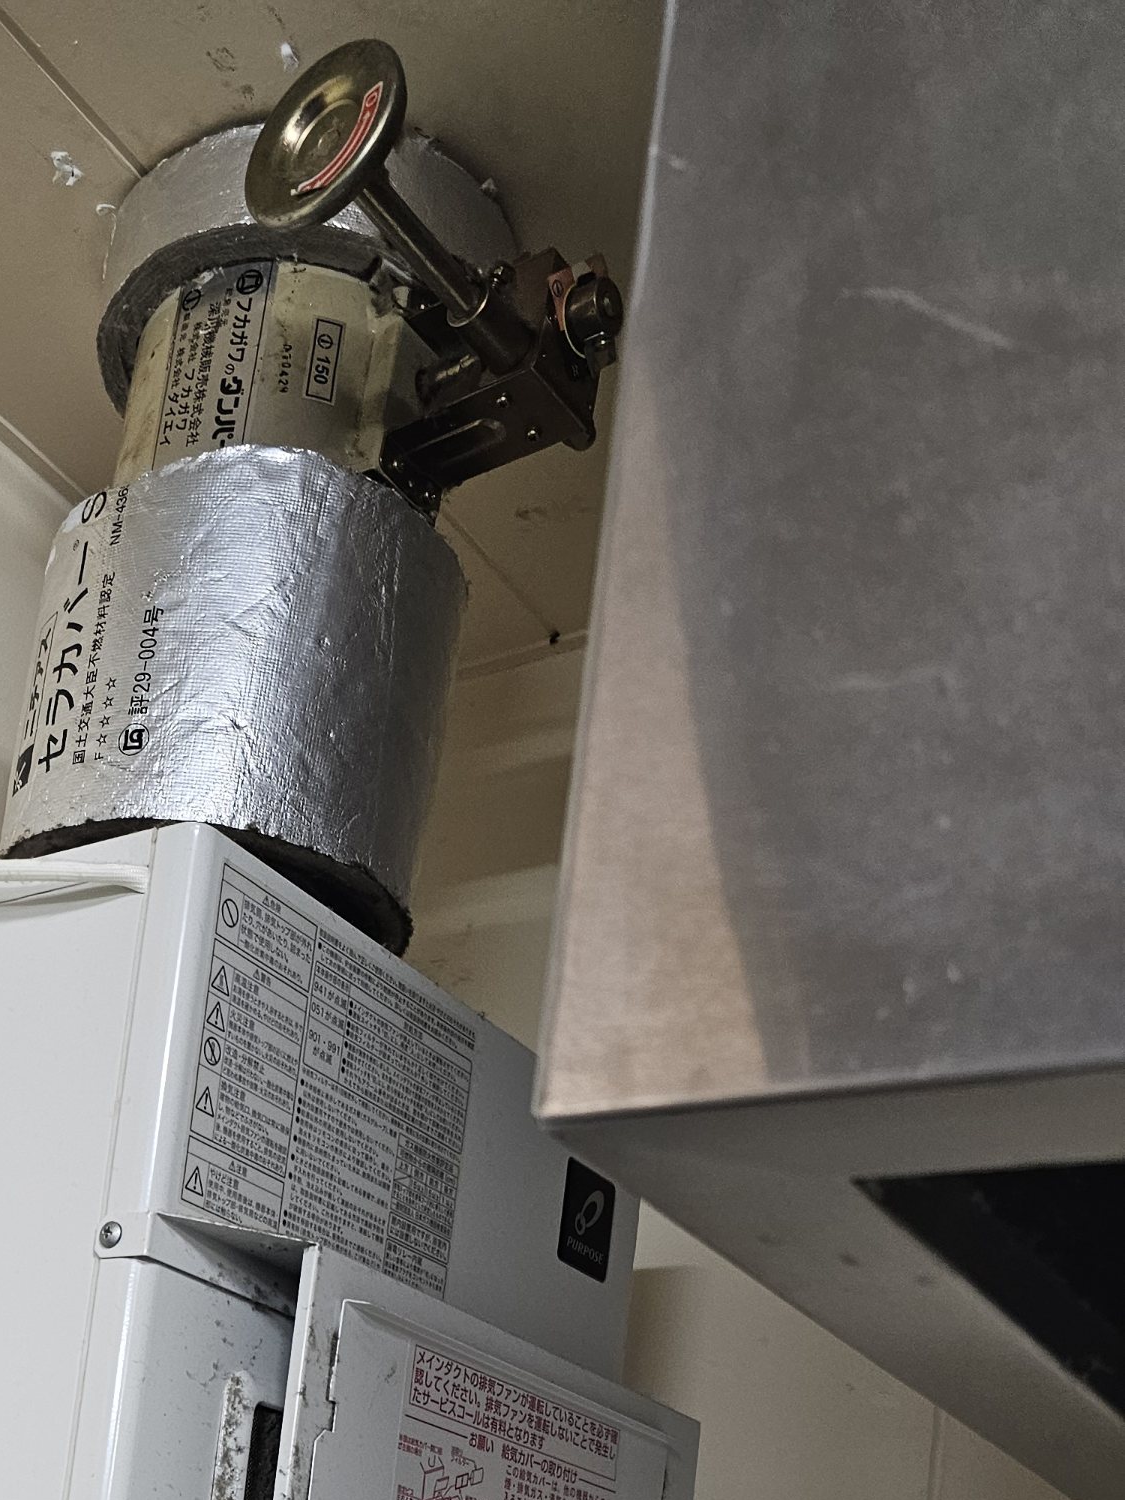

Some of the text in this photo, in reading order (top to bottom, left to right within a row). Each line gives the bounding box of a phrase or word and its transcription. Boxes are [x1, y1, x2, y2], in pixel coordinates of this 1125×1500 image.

[175, 368, 196, 432] フカガワ
[313, 356, 333, 386] 150
[159, 392, 181, 447] ダイエイ
[109, 483, 130, 547] NM-436
[38, 491, 108, 774] セラカバー S
[127, 604, 165, 717] 評29-004号
[72, 571, 117, 766] 国土交通大臣不燃材料認定
[567, 1235, 604, 1265] PURPOSE
[412, 1385, 545, 1451] たサービスコールは有料となります
[414, 1366, 616, 1461] 認してください。排気ファンを運転しないことで発生し
[416, 1347, 618, 1445] メインダクトの排気ファンが運転していることを必ず確
[468, 1431, 494, 1454] お願い
[501, 1443, 577, 1485] 給気カバーの取り付け
